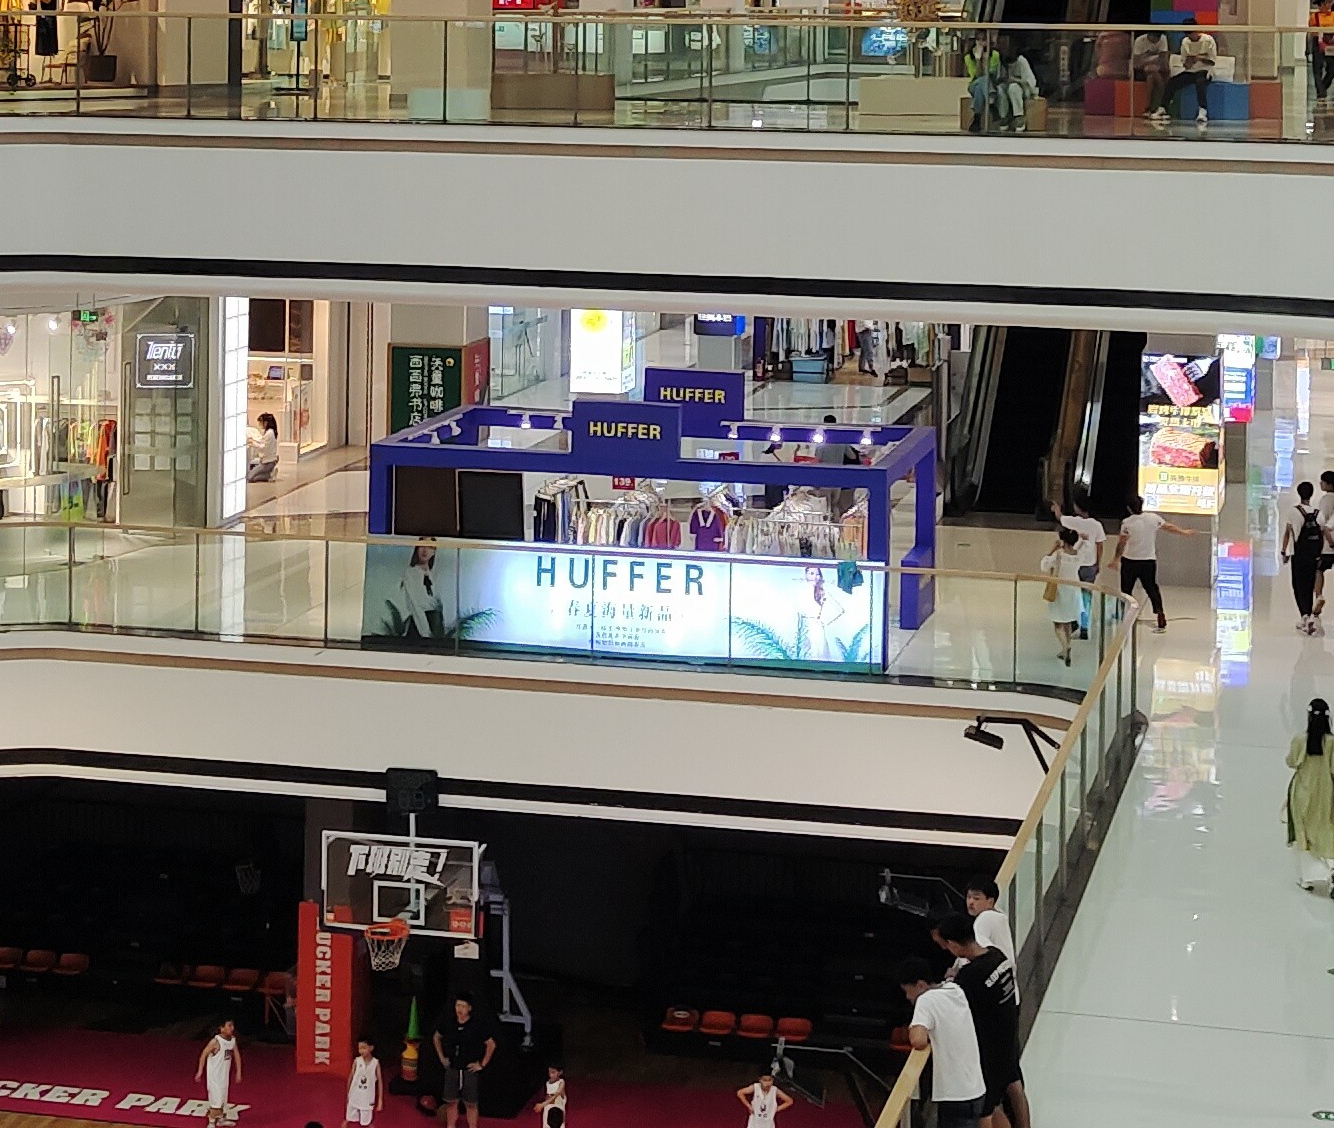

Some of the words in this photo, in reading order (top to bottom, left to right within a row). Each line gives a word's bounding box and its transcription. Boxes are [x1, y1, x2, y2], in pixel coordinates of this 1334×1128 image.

[408, 355, 423, 427] 西西弗书店
[429, 356, 444, 413] 矢量咖啡
[659, 386, 727, 405] HUFFER
[588, 420, 662, 441] HUFFER
[536, 555, 705, 596] HUFFER
[314, 1007, 332, 1066] PARK
[115, 1093, 252, 1122] PARK
